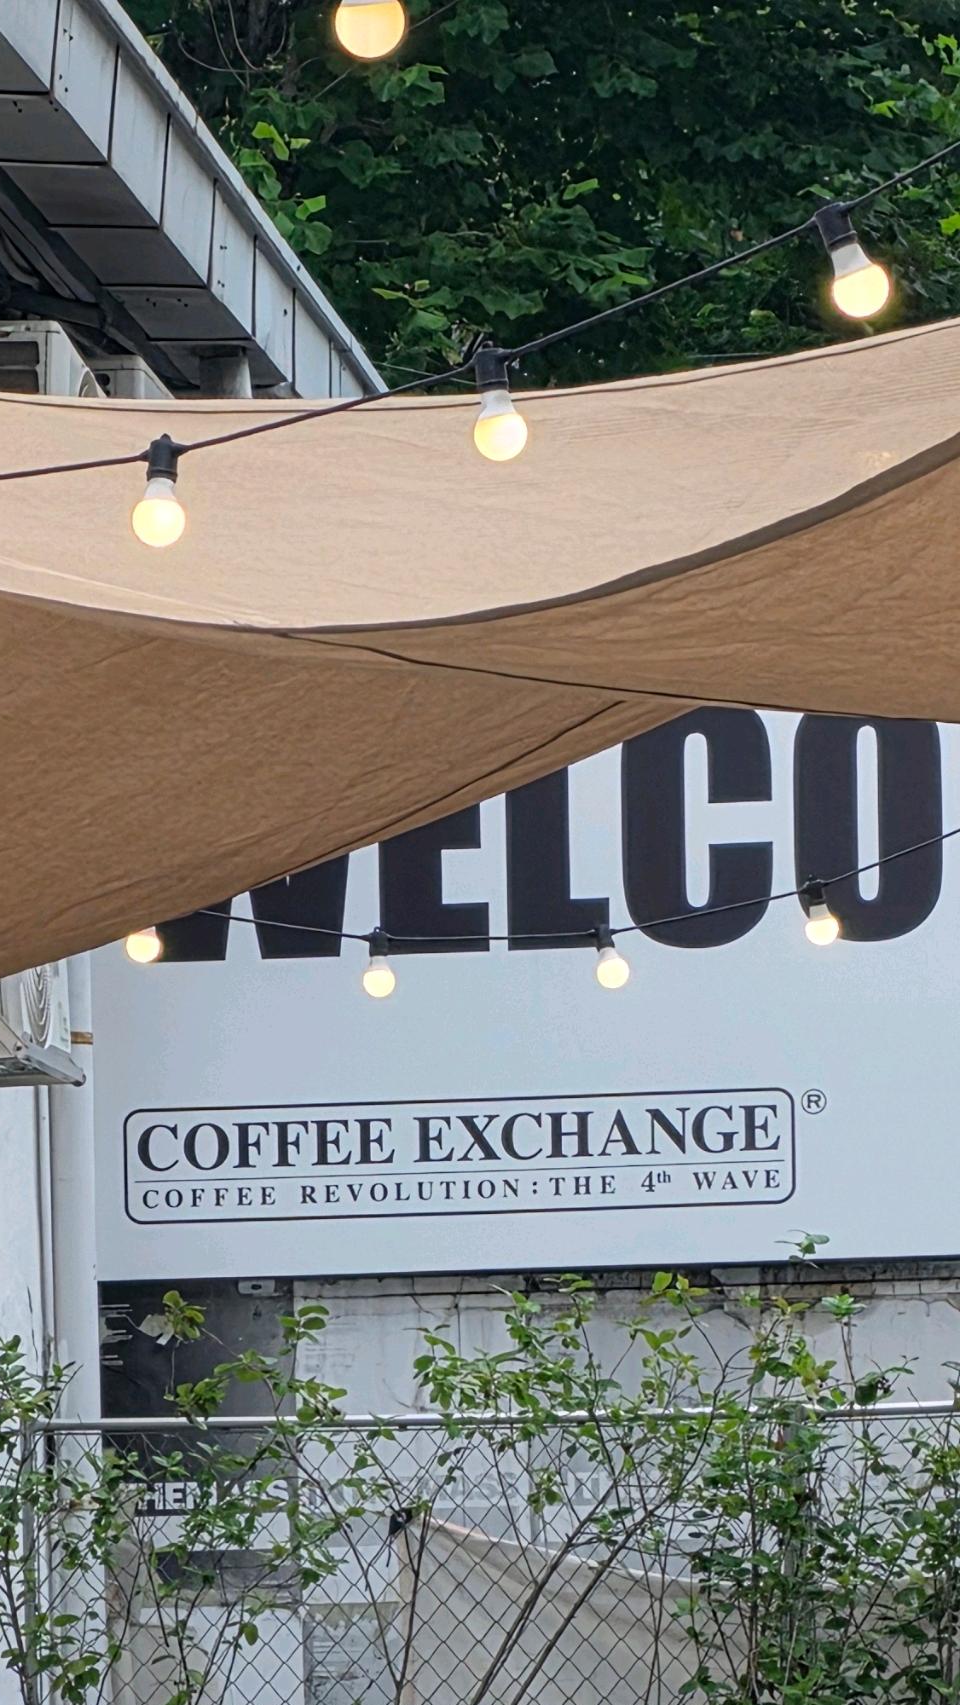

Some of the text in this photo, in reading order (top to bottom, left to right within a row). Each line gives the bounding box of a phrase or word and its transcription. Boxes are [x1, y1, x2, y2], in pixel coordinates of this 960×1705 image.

[137, 1118, 396, 1172] COFFEE
[413, 1104, 781, 1164] EXCHANGE
[142, 1186, 277, 1209] COFFEE
[640, 1170, 672, 1193] 4th
[692, 1169, 781, 1191] WAVE
